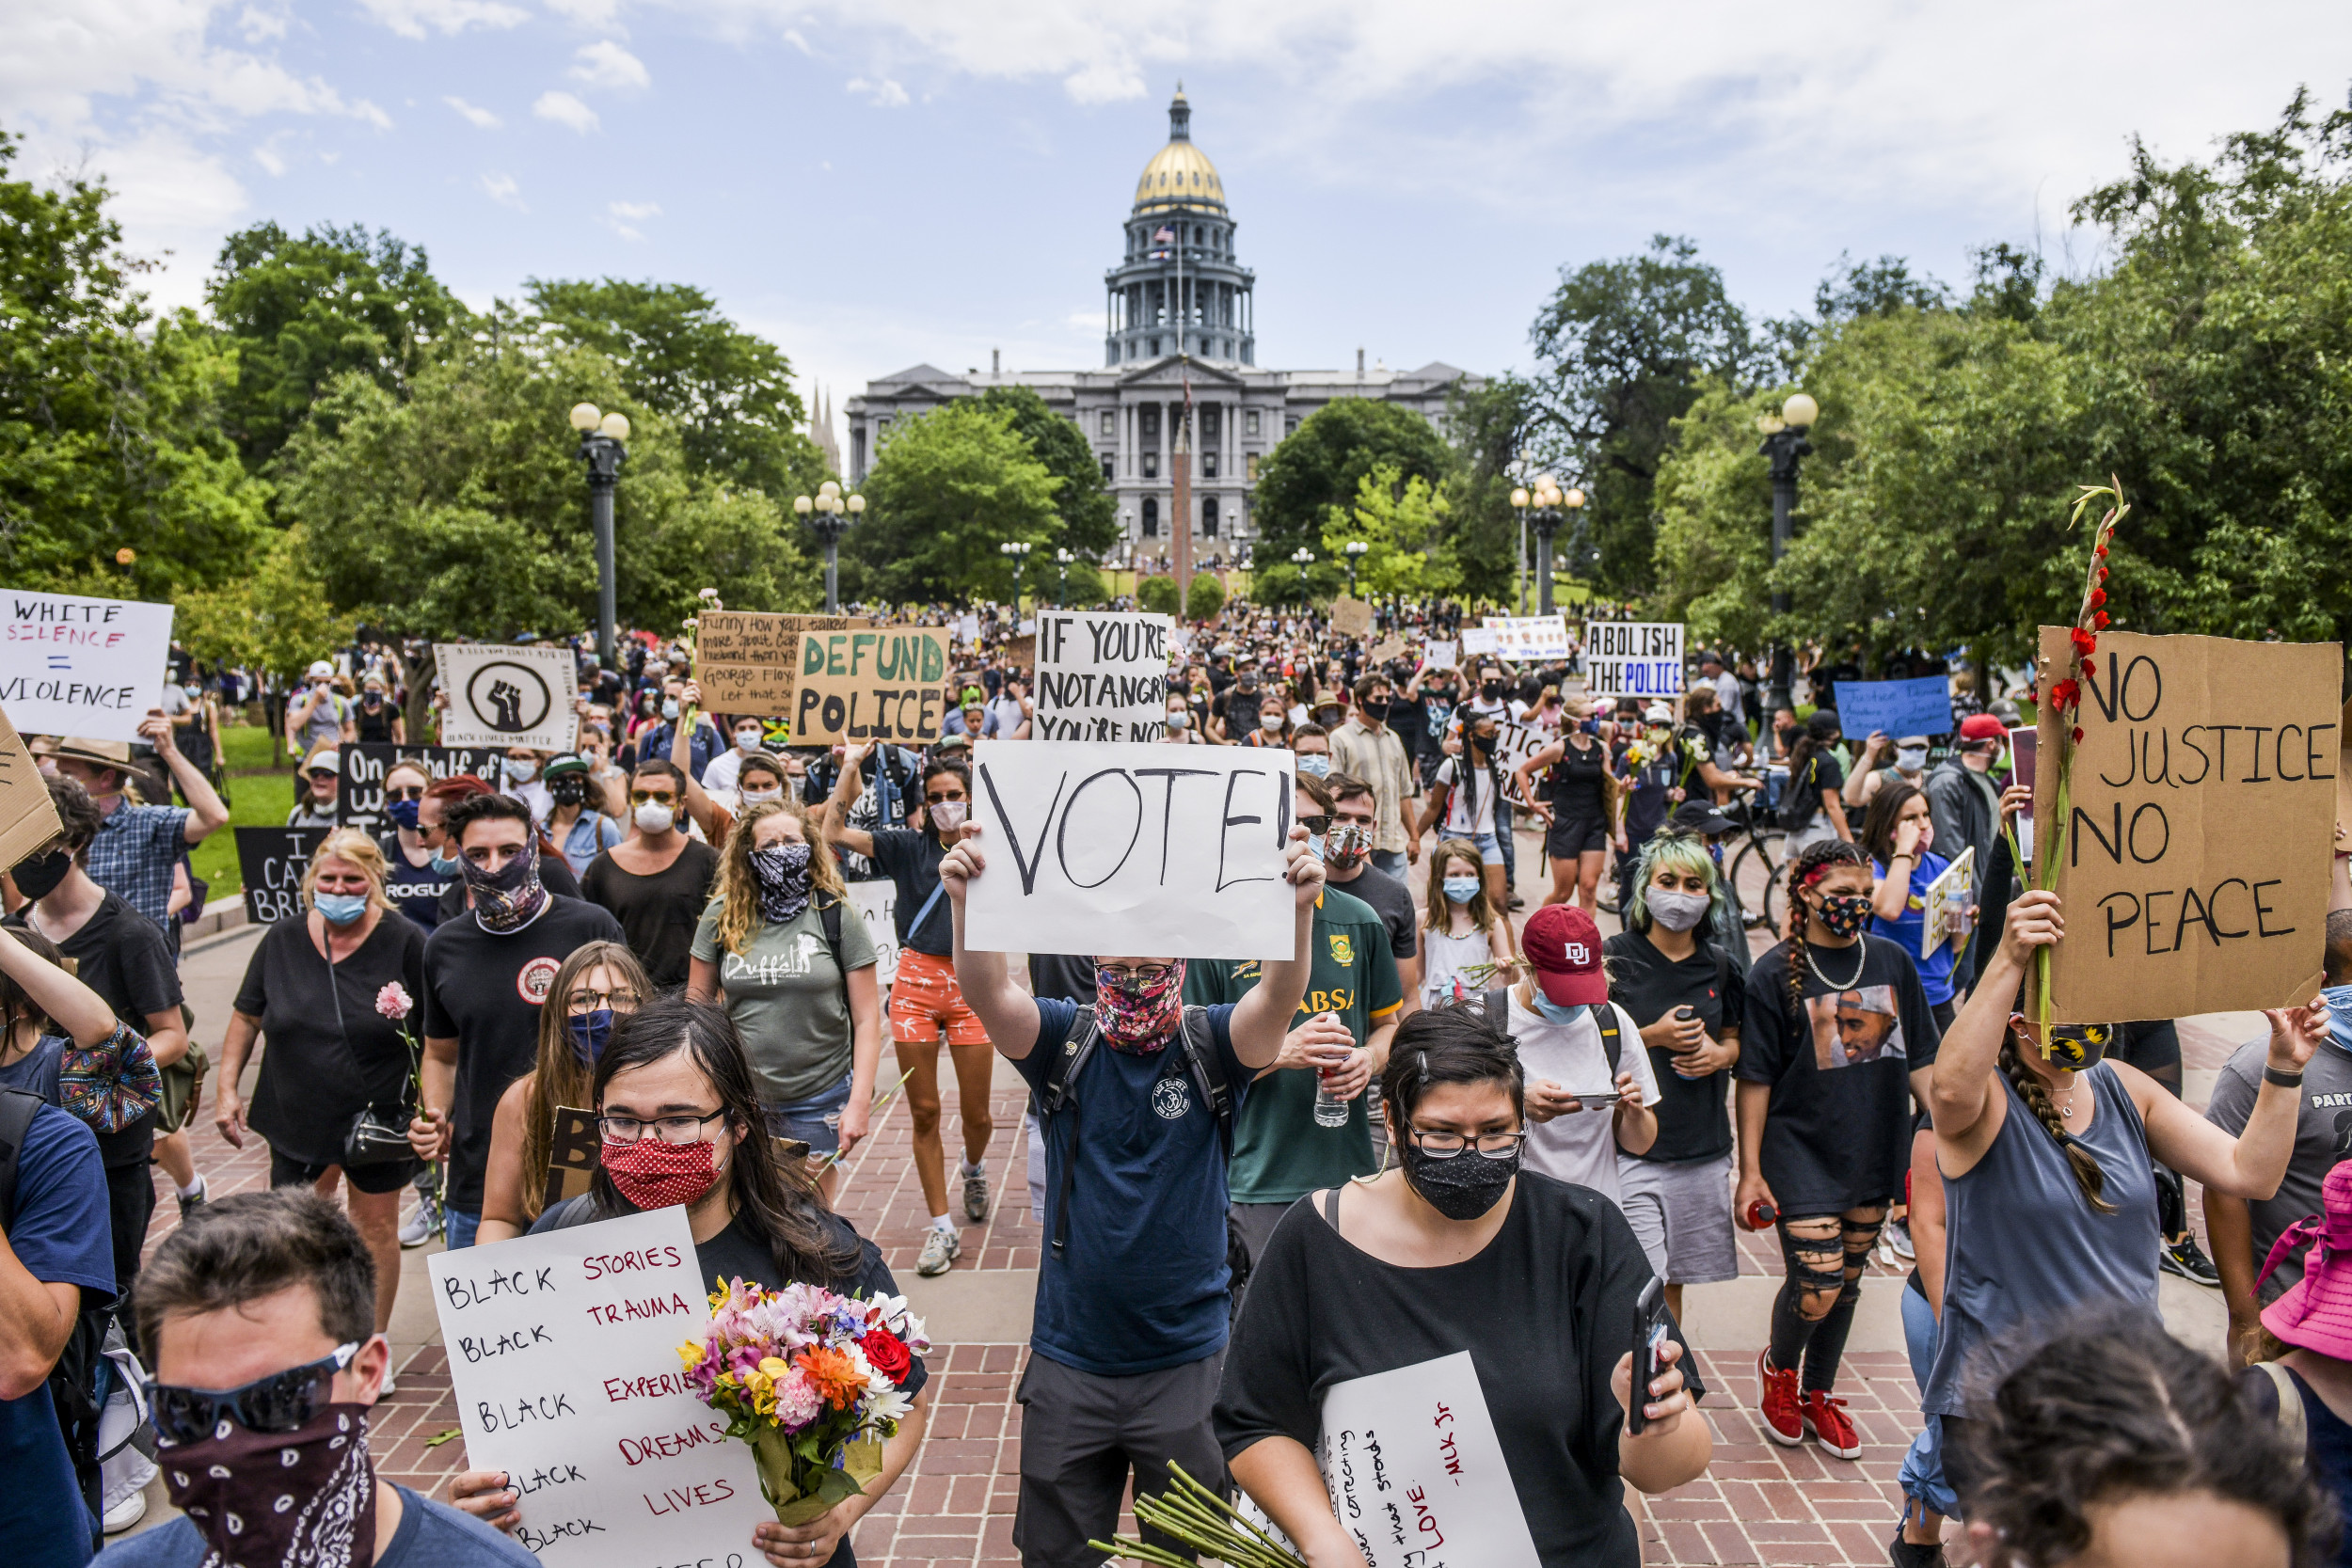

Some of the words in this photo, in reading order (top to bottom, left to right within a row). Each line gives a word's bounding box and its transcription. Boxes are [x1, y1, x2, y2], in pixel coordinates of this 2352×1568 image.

[14, 599, 122, 624] WHITE
[701, 614, 745, 636] Funny
[809, 617, 847, 631] talked
[8, 625, 125, 648] SILENCE
[803, 634, 944, 683] DEFUND
[1041, 617, 1073, 663] IF
[1086, 619, 1167, 664] YOU'RE
[1589, 626, 1677, 657] ABOLISH
[0, 676, 135, 709] VIOLENCE
[1038, 671, 1096, 710] NOT
[1096, 673, 1167, 708] ANGRY
[1589, 661, 1621, 692] THE
[1626, 662, 1680, 693] POLICE
[2073, 652, 2162, 723] NO
[797, 688, 941, 739] POLICE
[1037, 713, 1123, 742] YOU'RE
[1130, 721, 1167, 742] NOT
[348, 749, 384, 784] On
[476, 752, 500, 780] of
[2100, 723, 2337, 788] JUSTICE
[285, 833, 308, 860] I
[978, 762, 1290, 895] VOTE!
[2071, 801, 2169, 867] NO
[2097, 878, 2296, 958] PEACE
[444, 1266, 556, 1309] BLACK
[583, 1245, 682, 1280] STORIES
[458, 1324, 553, 1363] BLACK
[586, 1292, 691, 1325] TRAUMA
[477, 1393, 576, 1433] BLACK
[501, 1464, 587, 1501] BLACK
[619, 1421, 726, 1465] DREAMS
[1340, 1430, 1361, 1519] correcting
[515, 1518, 606, 1554] BLACK
[644, 1479, 735, 1515] LIVES
[1381, 1502, 1406, 1545] that
[1353, 1528, 1377, 1568] ower
